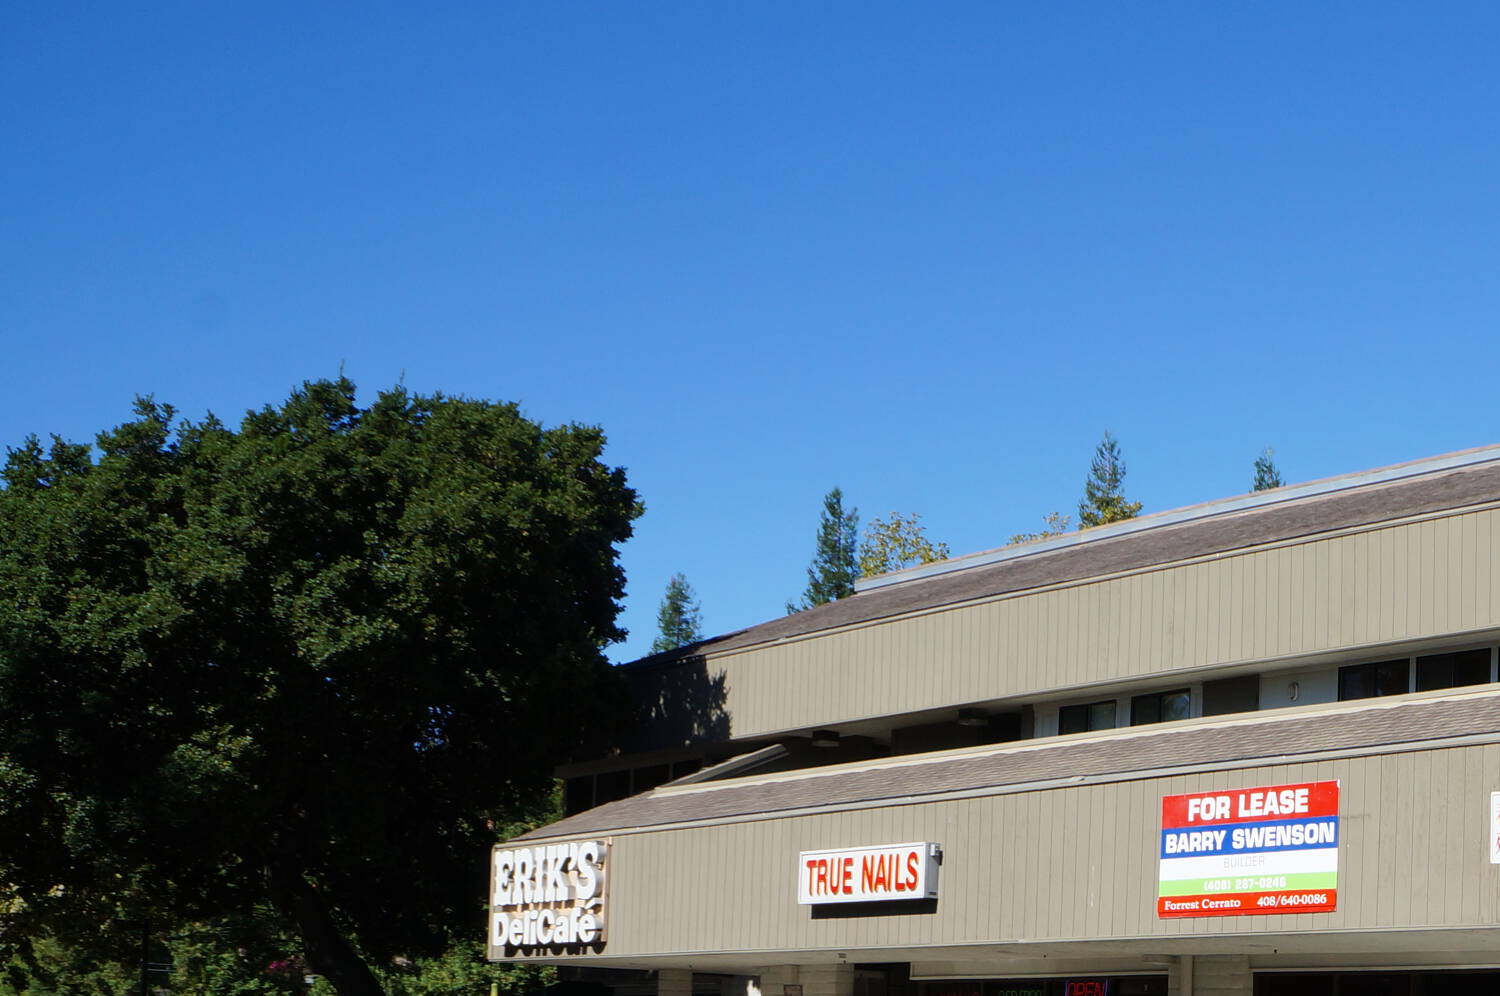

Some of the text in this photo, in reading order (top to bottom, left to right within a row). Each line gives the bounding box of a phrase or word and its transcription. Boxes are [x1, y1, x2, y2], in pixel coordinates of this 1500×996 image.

[1187, 788, 1309, 822] FOR LEASE
[1165, 822, 1336, 855] BARRY SWENSON
[493, 841, 601, 906] ERIK'S
[806, 851, 919, 897] TRUE NAILS
[1223, 855, 1265, 869] BUILDER
[1164, 893, 1327, 911] Forrest Cerrato 408/640-0086
[1204, 879, 1231, 892] (408)
